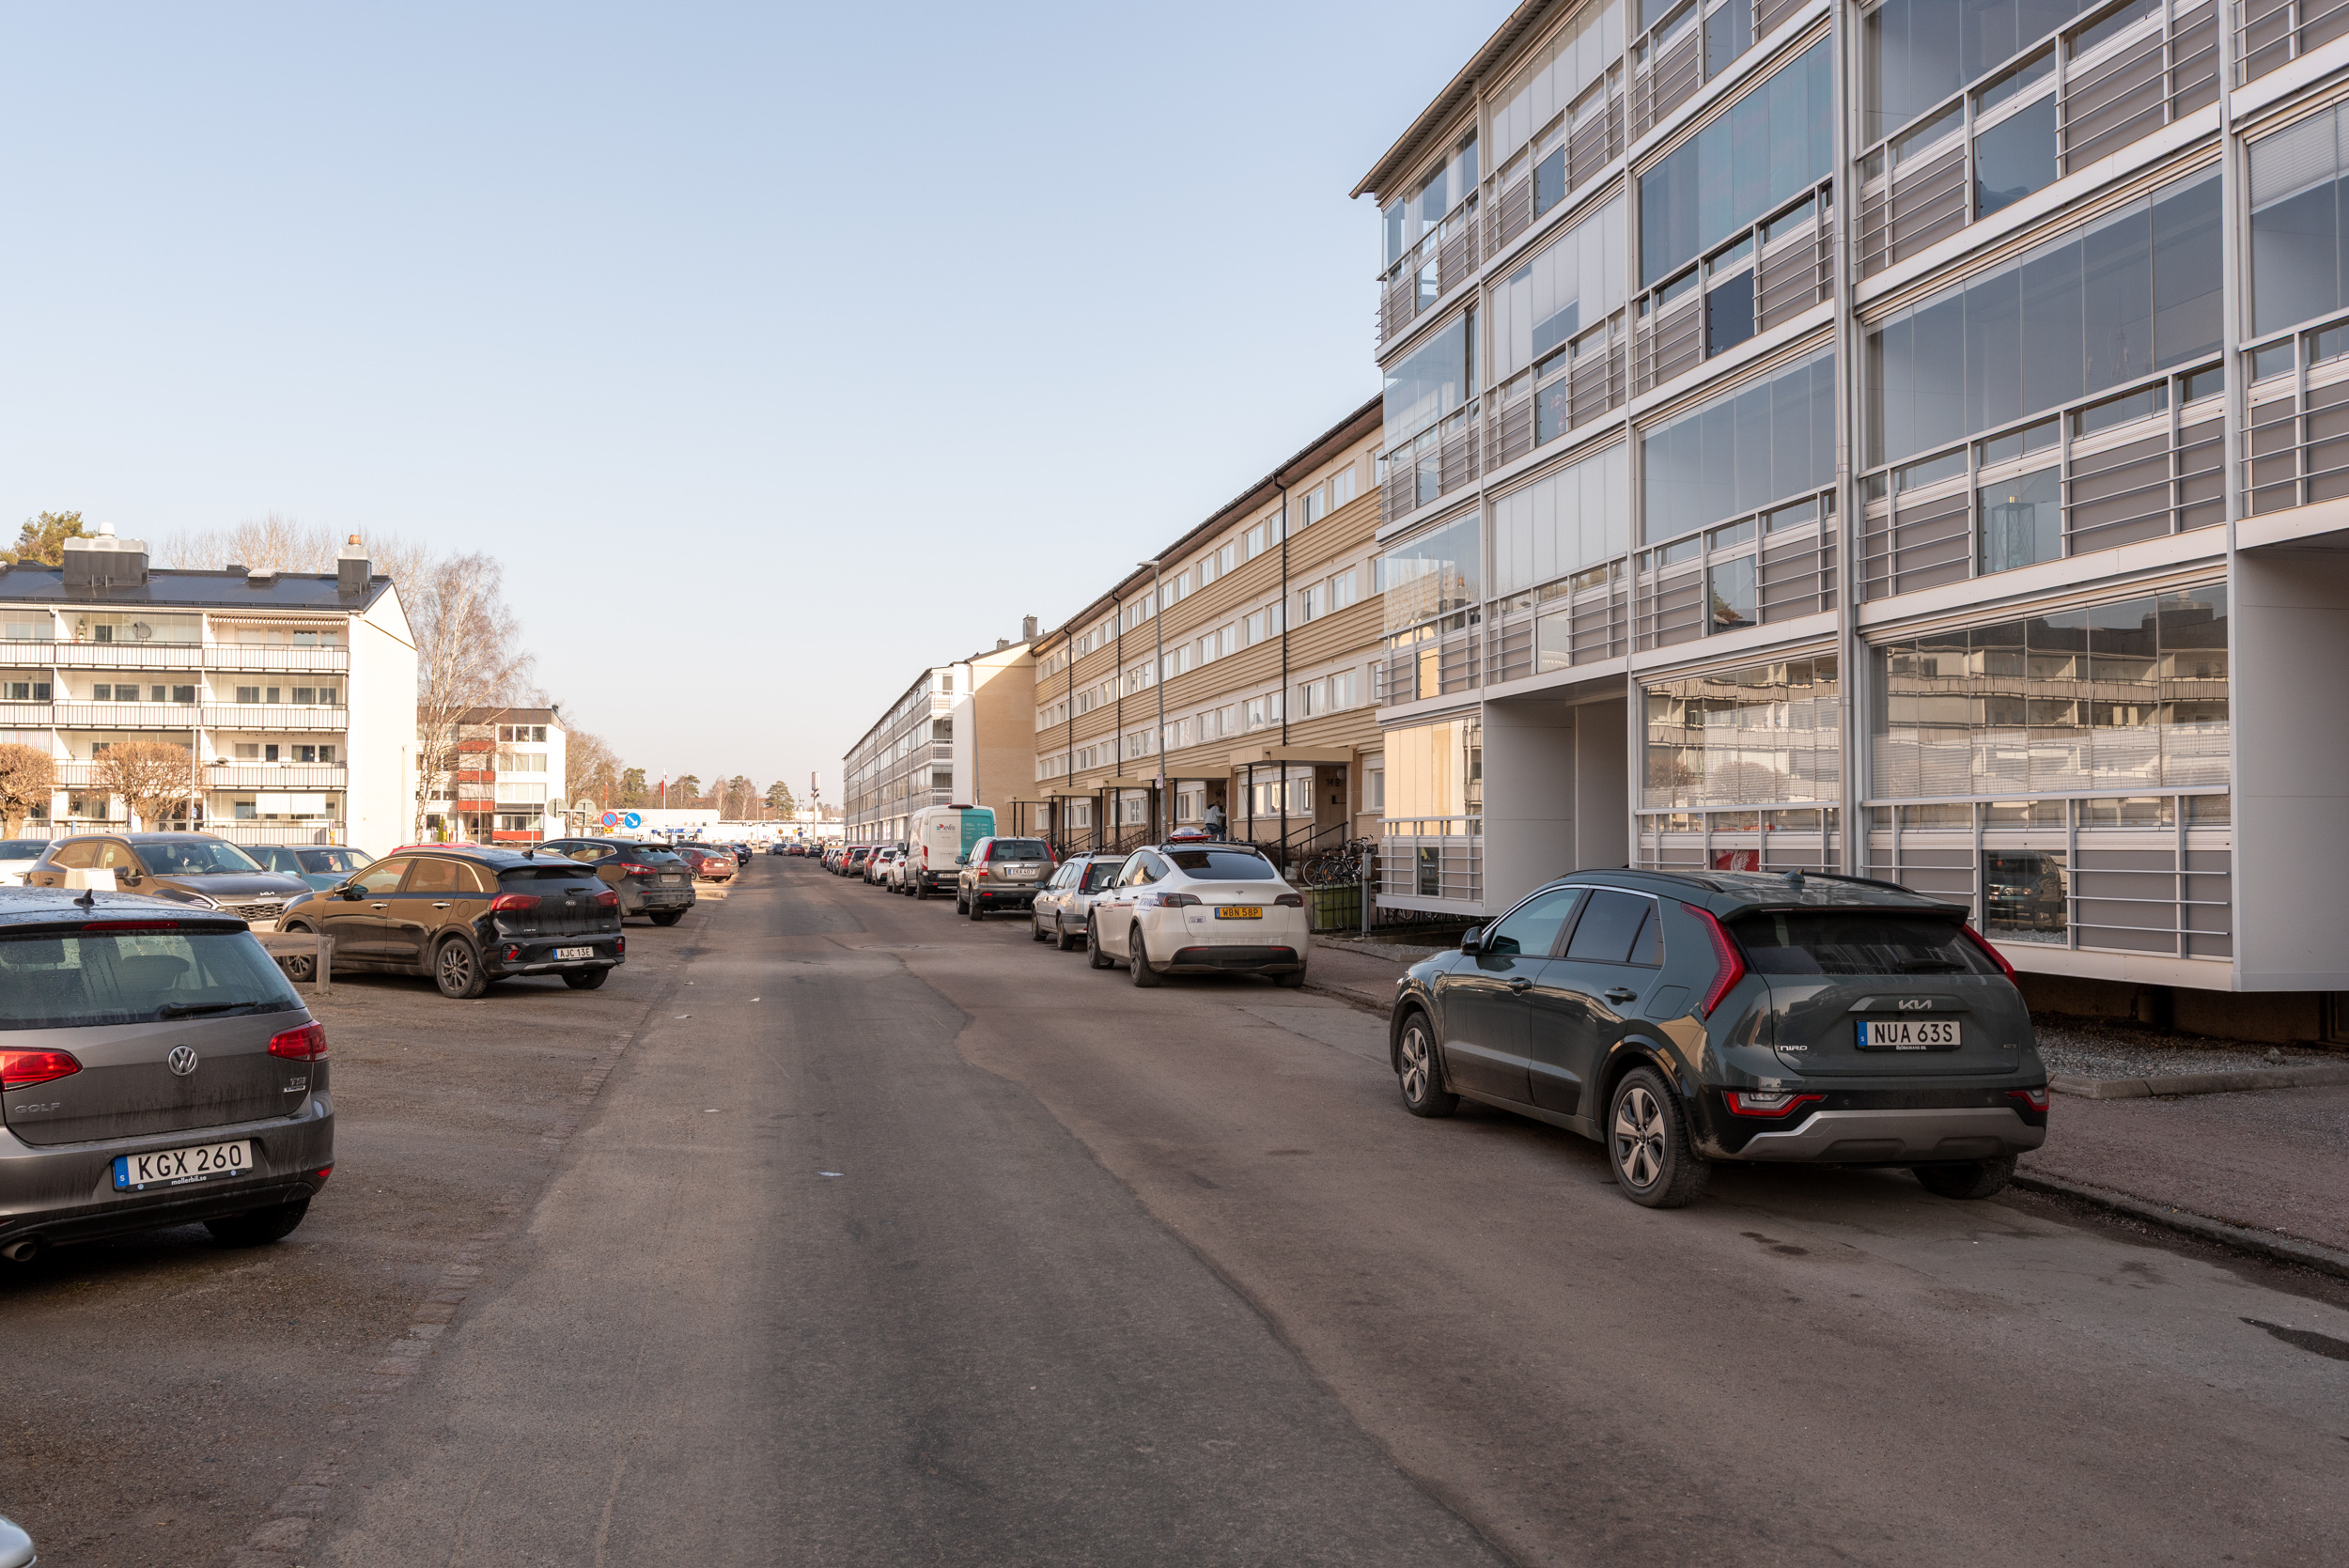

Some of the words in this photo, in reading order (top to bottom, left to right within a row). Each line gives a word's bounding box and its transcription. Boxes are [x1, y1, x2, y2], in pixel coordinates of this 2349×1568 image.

[1222, 908, 1240, 917] WBN
[1241, 908, 1259, 917] 58P
[560, 948, 575, 958] AJC
[576, 947, 590, 956] 13E
[1898, 999, 1933, 1010] KIA
[1875, 1023, 1911, 1044] NUA
[1917, 1022, 1953, 1043] 63S
[168, 1045, 198, 1077] VW
[14, 1102, 61, 1114] GOLF
[137, 1151, 189, 1181] KGX
[195, 1144, 242, 1172] 260
[171, 1174, 208, 1186] mollerbil.se
